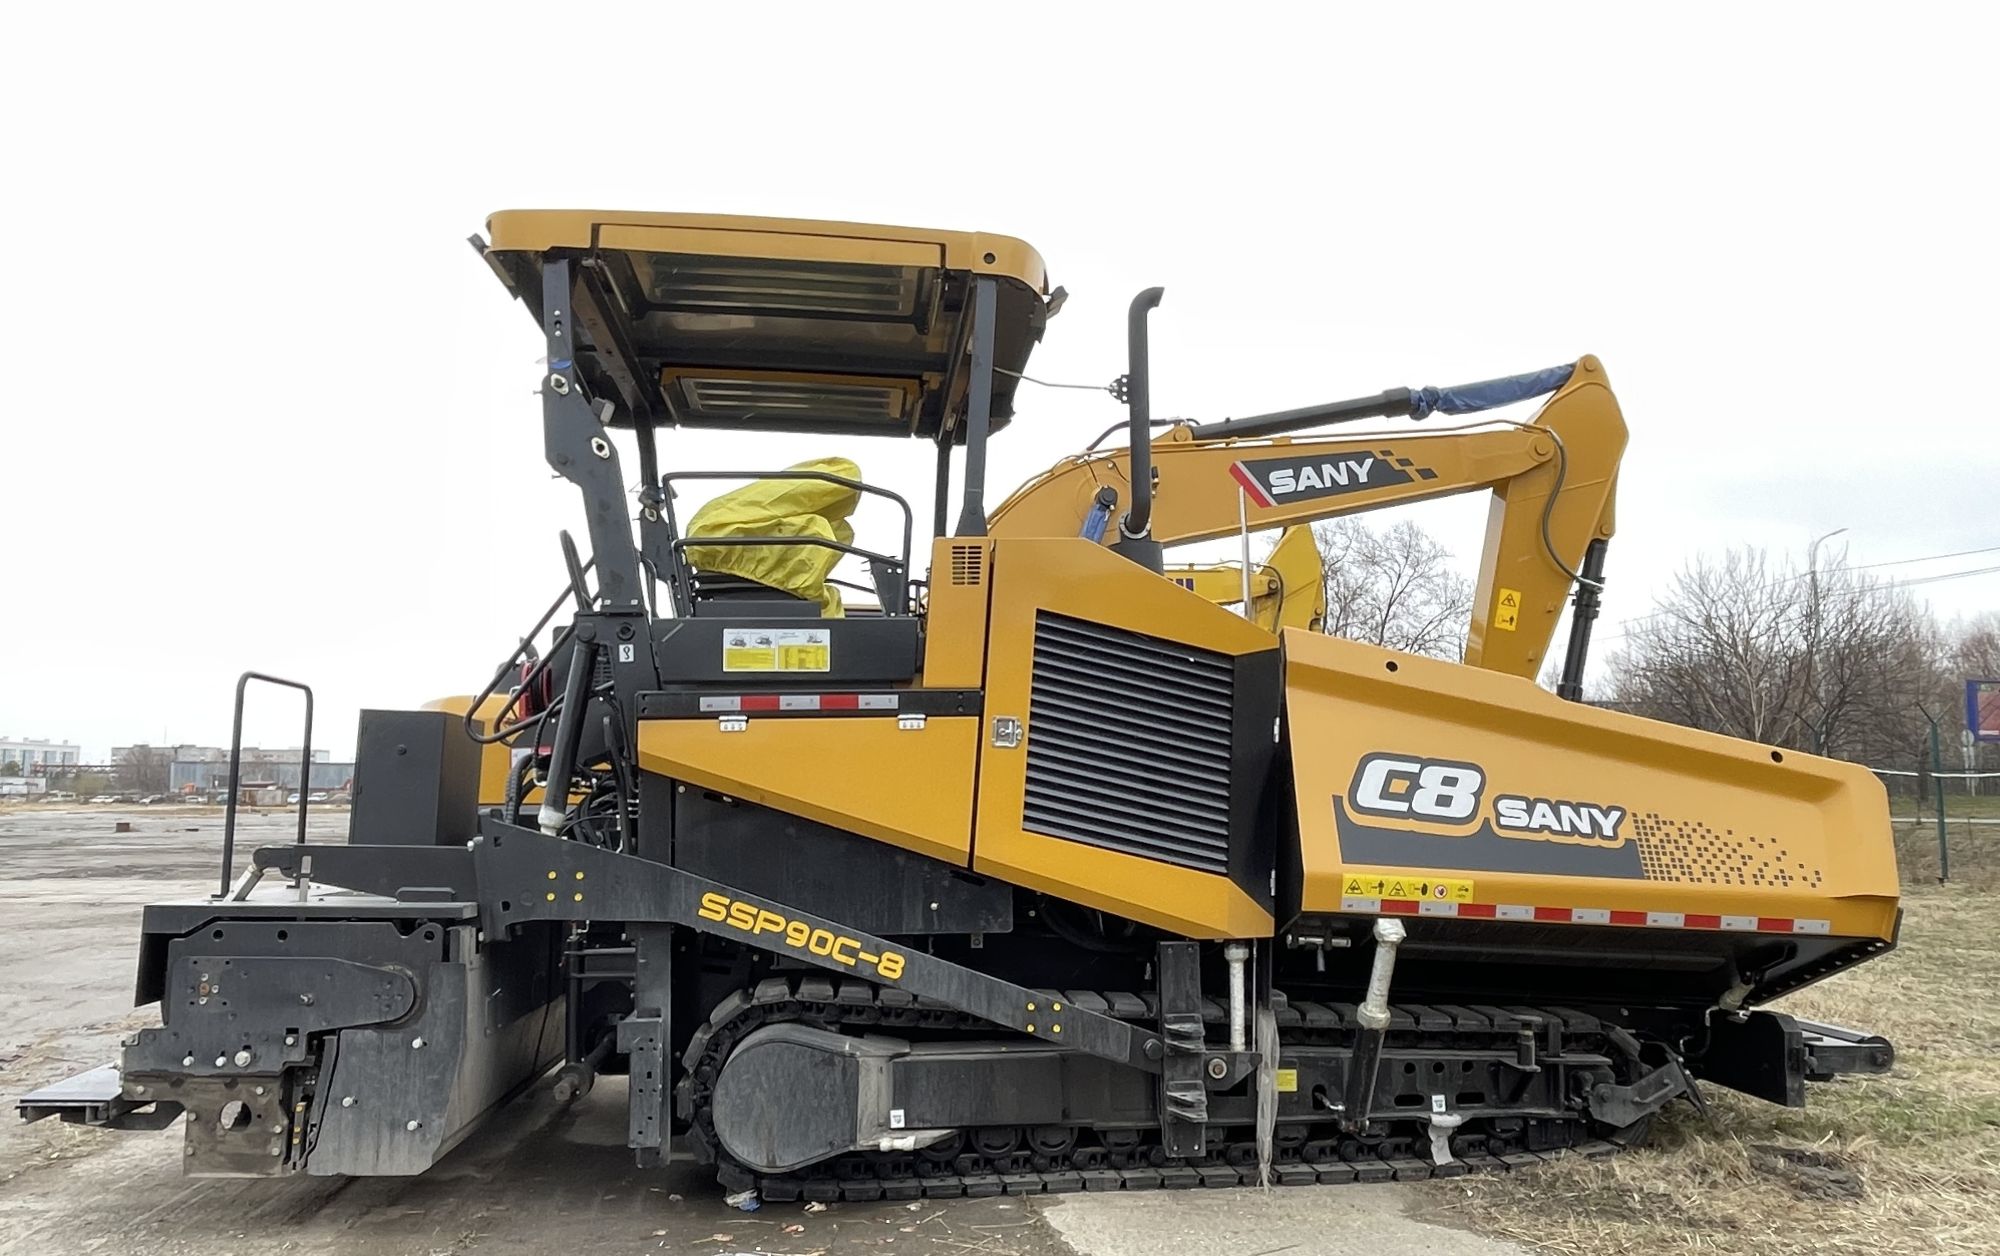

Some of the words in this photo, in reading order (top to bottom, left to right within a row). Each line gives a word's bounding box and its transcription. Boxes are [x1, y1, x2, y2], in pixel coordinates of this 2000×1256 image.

[1269, 457, 1375, 495] SANY
[1355, 758, 1483, 818] C8
[1497, 798, 1623, 838] SANY
[697, 891, 906, 980] SSP90C-8
